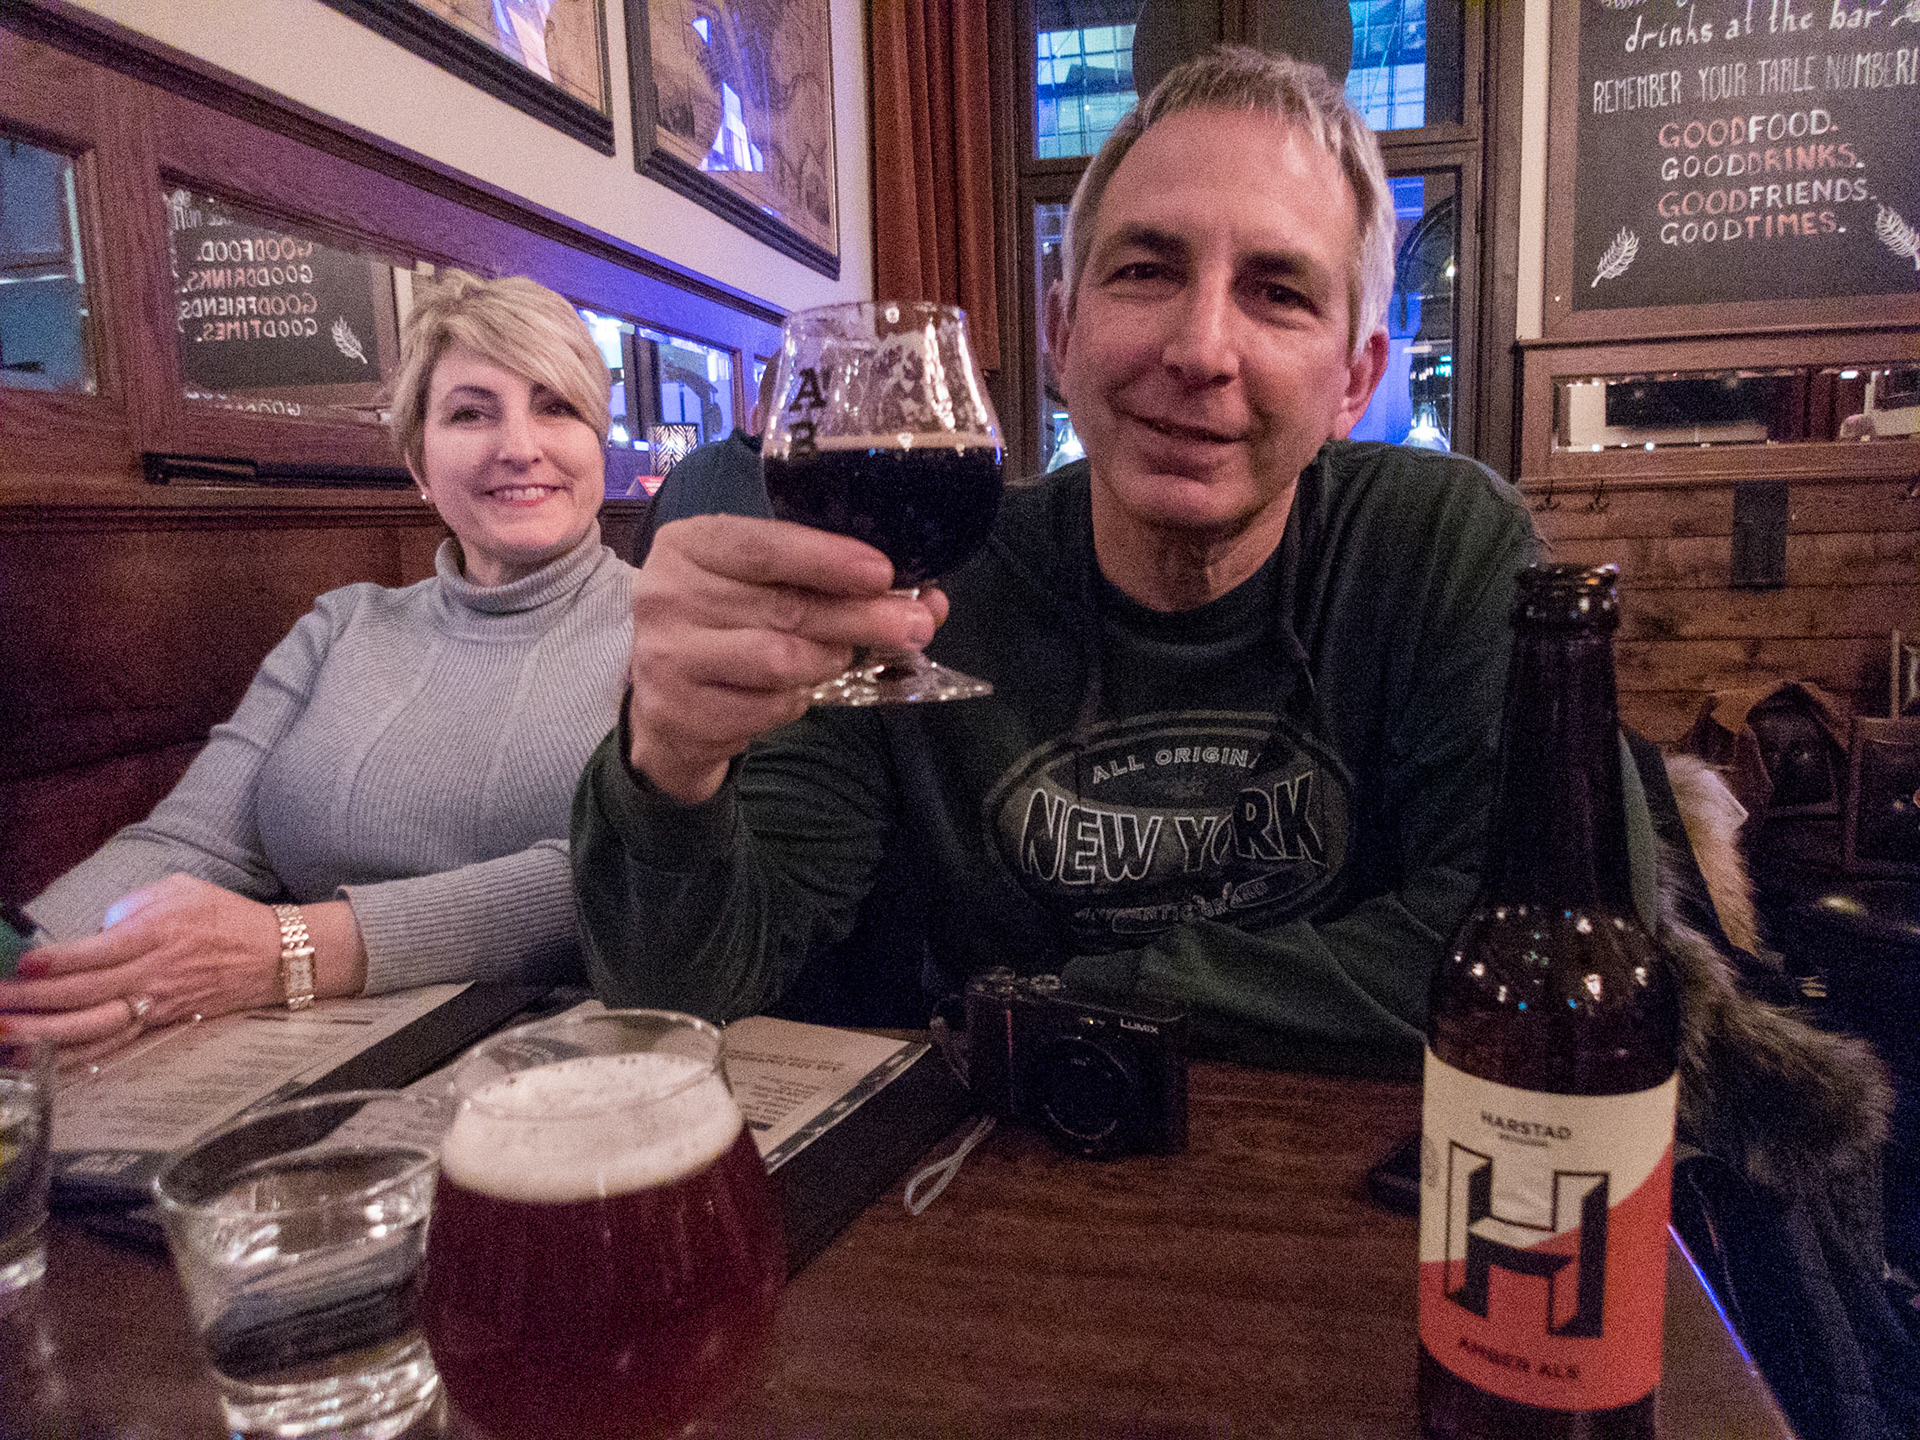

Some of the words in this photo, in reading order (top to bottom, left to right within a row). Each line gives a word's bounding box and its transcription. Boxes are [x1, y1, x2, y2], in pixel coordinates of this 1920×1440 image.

[1625, 3, 1712, 52] drinks
[1725, 0, 1754, 41] at
[1768, 0, 1813, 33] the
[1828, 0, 1882, 30] bar
[1593, 70, 1682, 114] REMEMBER
[1698, 62, 1748, 102] YOUR
[1757, 55, 1816, 95] TABLE
[1092, 754, 1146, 784] ALL
[1155, 746, 1262, 770] ORIGIN
[1020, 787, 1164, 885] NEW
[1480, 1110, 1572, 1140] HARSTAD
